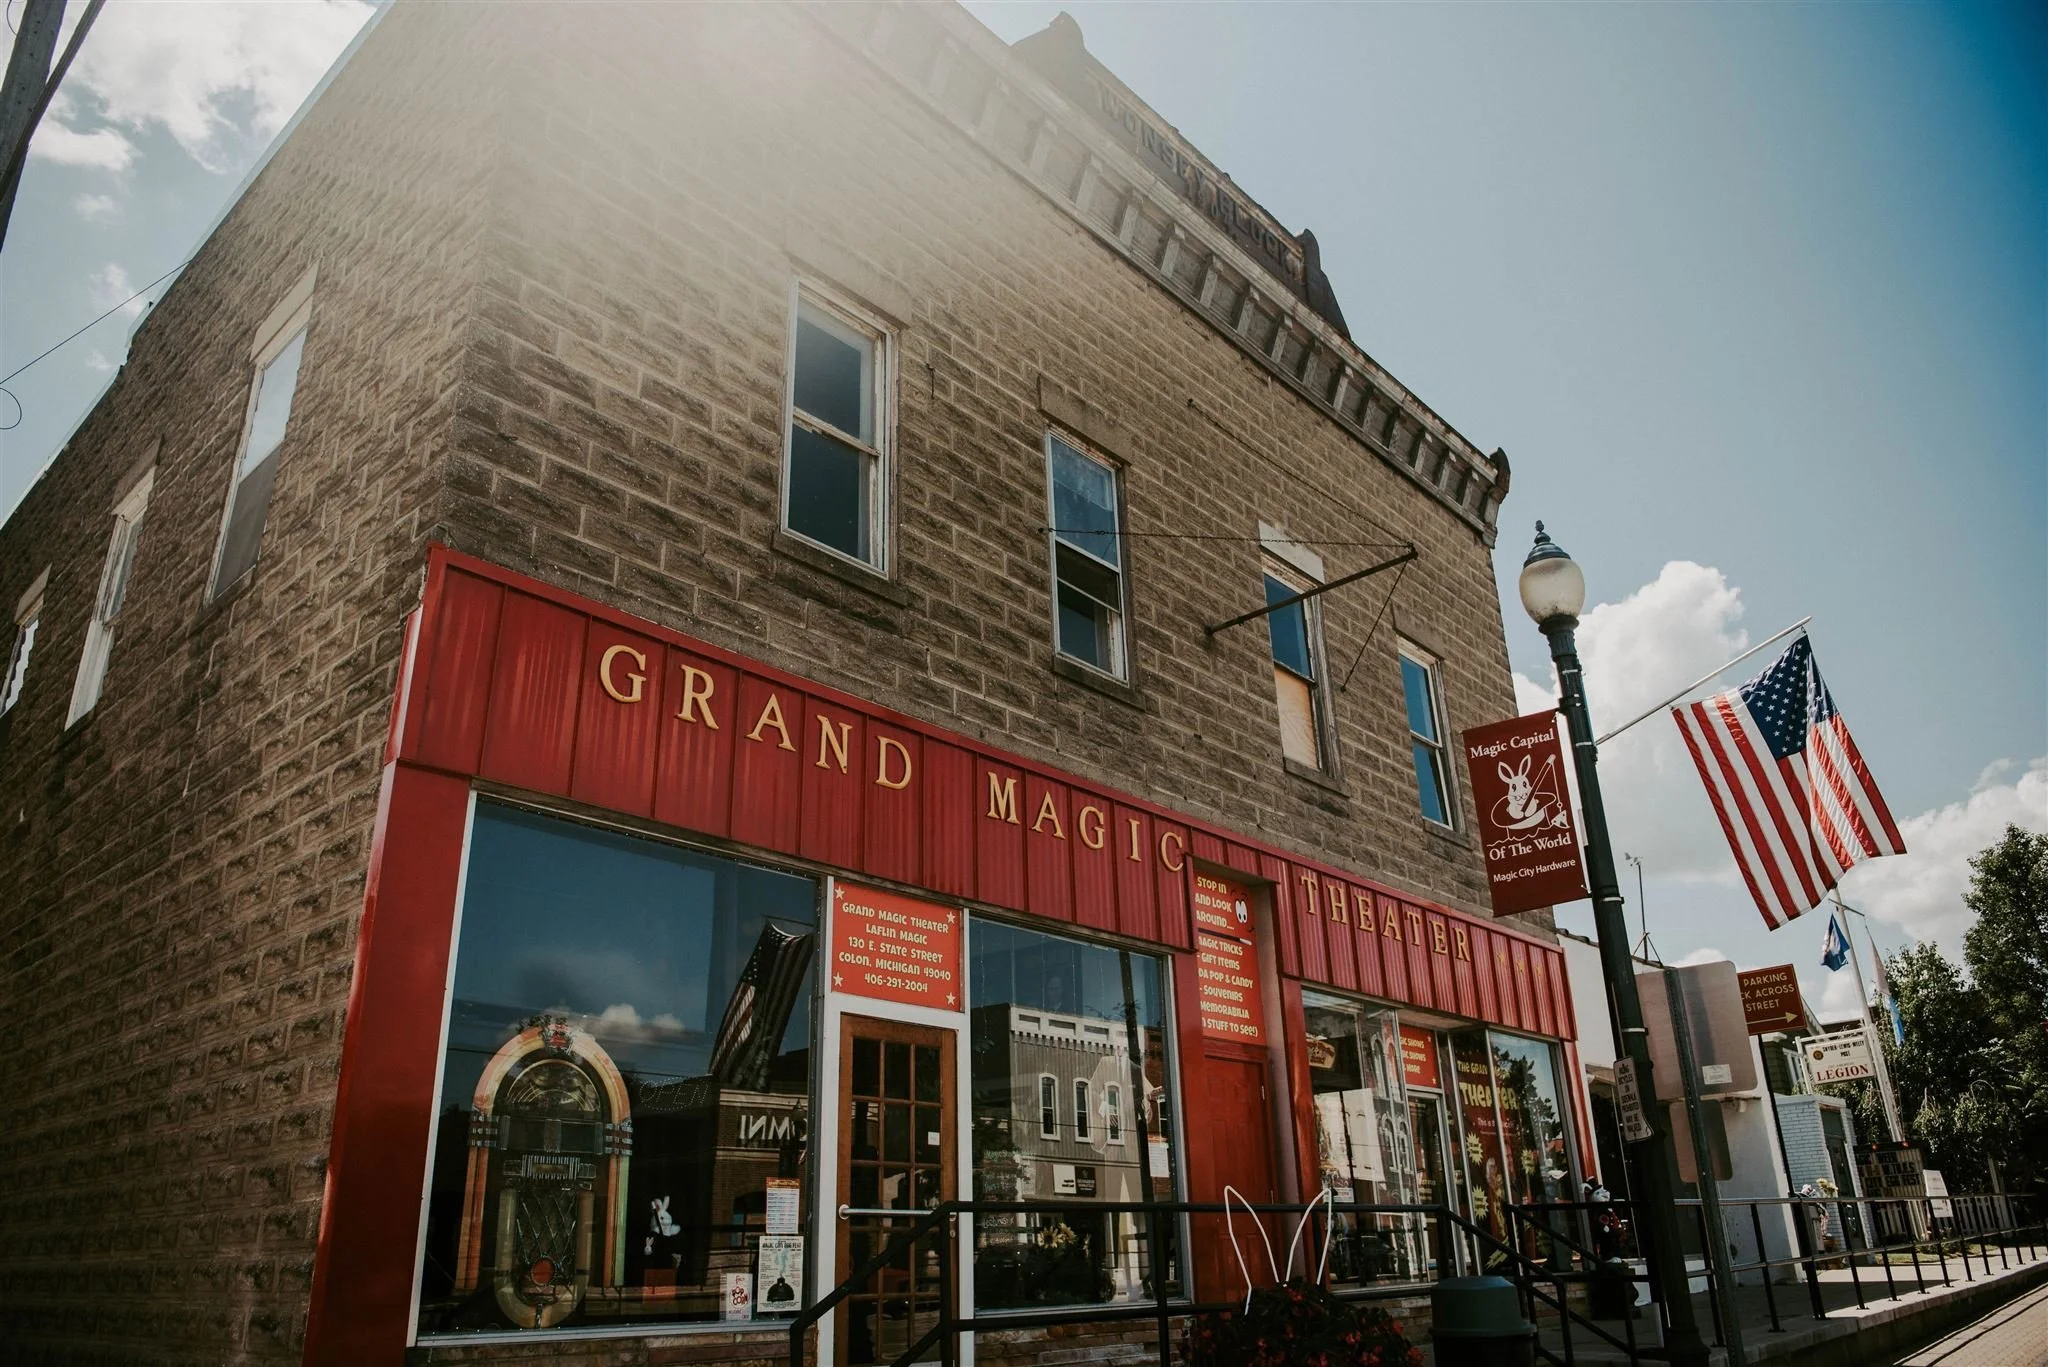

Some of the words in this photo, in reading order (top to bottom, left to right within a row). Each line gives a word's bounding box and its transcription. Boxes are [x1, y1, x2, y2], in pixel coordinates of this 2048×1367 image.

[1216, 190, 1295, 276] BLOCK
[1470, 741, 1507, 759] Magic
[1510, 728, 1555, 749] Capital
[599, 644, 913, 790] GRAND
[986, 771, 1185, 873] MAGIC
[1300, 876, 1471, 962] THEATER
[1489, 845, 1506, 861] Of
[1509, 841, 1532, 857] The
[1533, 832, 1572, 849] World
[1493, 869, 1518, 883] Magic
[1519, 864, 1535, 879] City
[1536, 858, 1576, 874] Hardware
[1197, 876, 1217, 891] STOP
[1218, 883, 1227, 894] IN
[1195, 893, 1211, 906] AND
[1212, 898, 1232, 913] LOOK
[842, 902, 875, 918] GRAND
[878, 910, 908, 925] MAGIC
[910, 916, 949, 934] THEATER
[866, 923, 896, 939] LAFLIN
[899, 930, 928, 945] MAGIC
[848, 936, 865, 949] 130
[868, 940, 877, 952] E.
[879, 942, 908, 957] STATE
[911, 949, 943, 964] STREET
[1219, 942, 1243, 956] TRICKS
[875, 958, 921, 975] MICHIGAN
[923, 967, 951, 981] 49040
[1201, 953, 1217, 964] GIFT
[1217, 957, 1240, 970] ITEMS
[864, 973, 928, 993] 406-291-2004
[1209, 971, 1224, 982] POP
[1231, 975, 1254, 988] CANDY
[1743, 972, 1788, 987] PARKING
[1203, 985, 1243, 1002] SOUVENIRS
[1755, 984, 1795, 998] ACROSS
[1745, 999, 1781, 1012] STREET
[1207, 1018, 1229, 1031] STUFF
[1229, 1023, 1239, 1033] TO
[1457, 1060, 1470, 1072] THE
[1817, 1064, 1869, 1082] LEGION
[639, 1078, 709, 1107] OPEN
